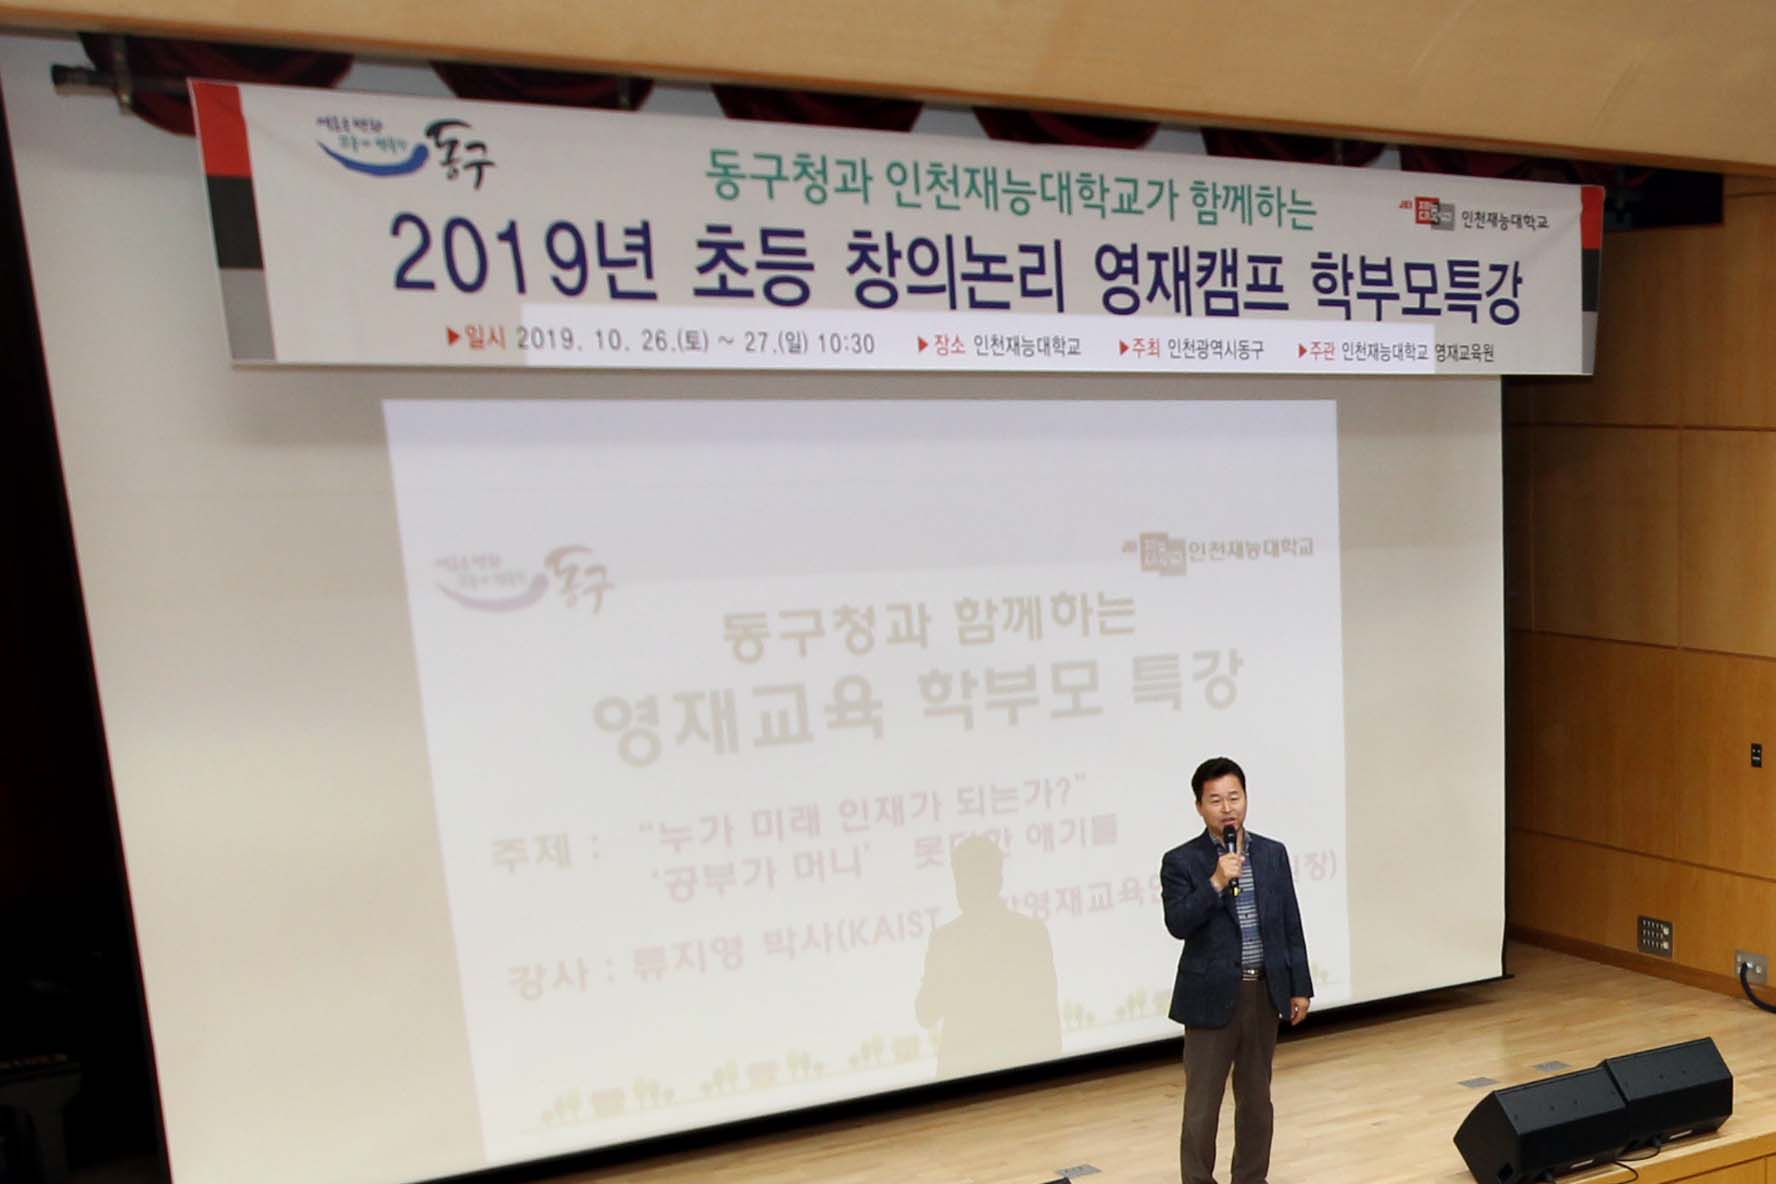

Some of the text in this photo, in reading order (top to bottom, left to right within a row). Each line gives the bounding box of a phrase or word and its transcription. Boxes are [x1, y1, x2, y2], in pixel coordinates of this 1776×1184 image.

[706, 147, 1318, 232] 동구청과 인천재능대학교가 함께하는
[1461, 210, 1549, 231] 인천재능대학교
[390, 212, 1523, 325] 2019년 초등 창의논리 영재캠프 학부모특강
[465, 325, 506, 350] 일시
[818, 332, 875, 354] 10:30
[934, 334, 966, 355] 장소
[973, 334, 1081, 358] 인천재능대학교
[1132, 337, 1161, 358] 주최
[1168, 337, 1265, 360] 인천광역시동구
[1309, 340, 1336, 361] 주관
[1342, 340, 1429, 363] 인천재능대학교
[1435, 343, 1495, 363] 영재교육원
[1188, 536, 1315, 563] 인천재능대학교
[722, 591, 1137, 664] 동구청과 함께하는
[592, 648, 1244, 768] 영재교육 학부모 특강
[492, 831, 573, 875] 주제
[751, 803, 822, 842] 미래
[838, 788, 942, 833] 인재가
[508, 957, 588, 1000] 강사
